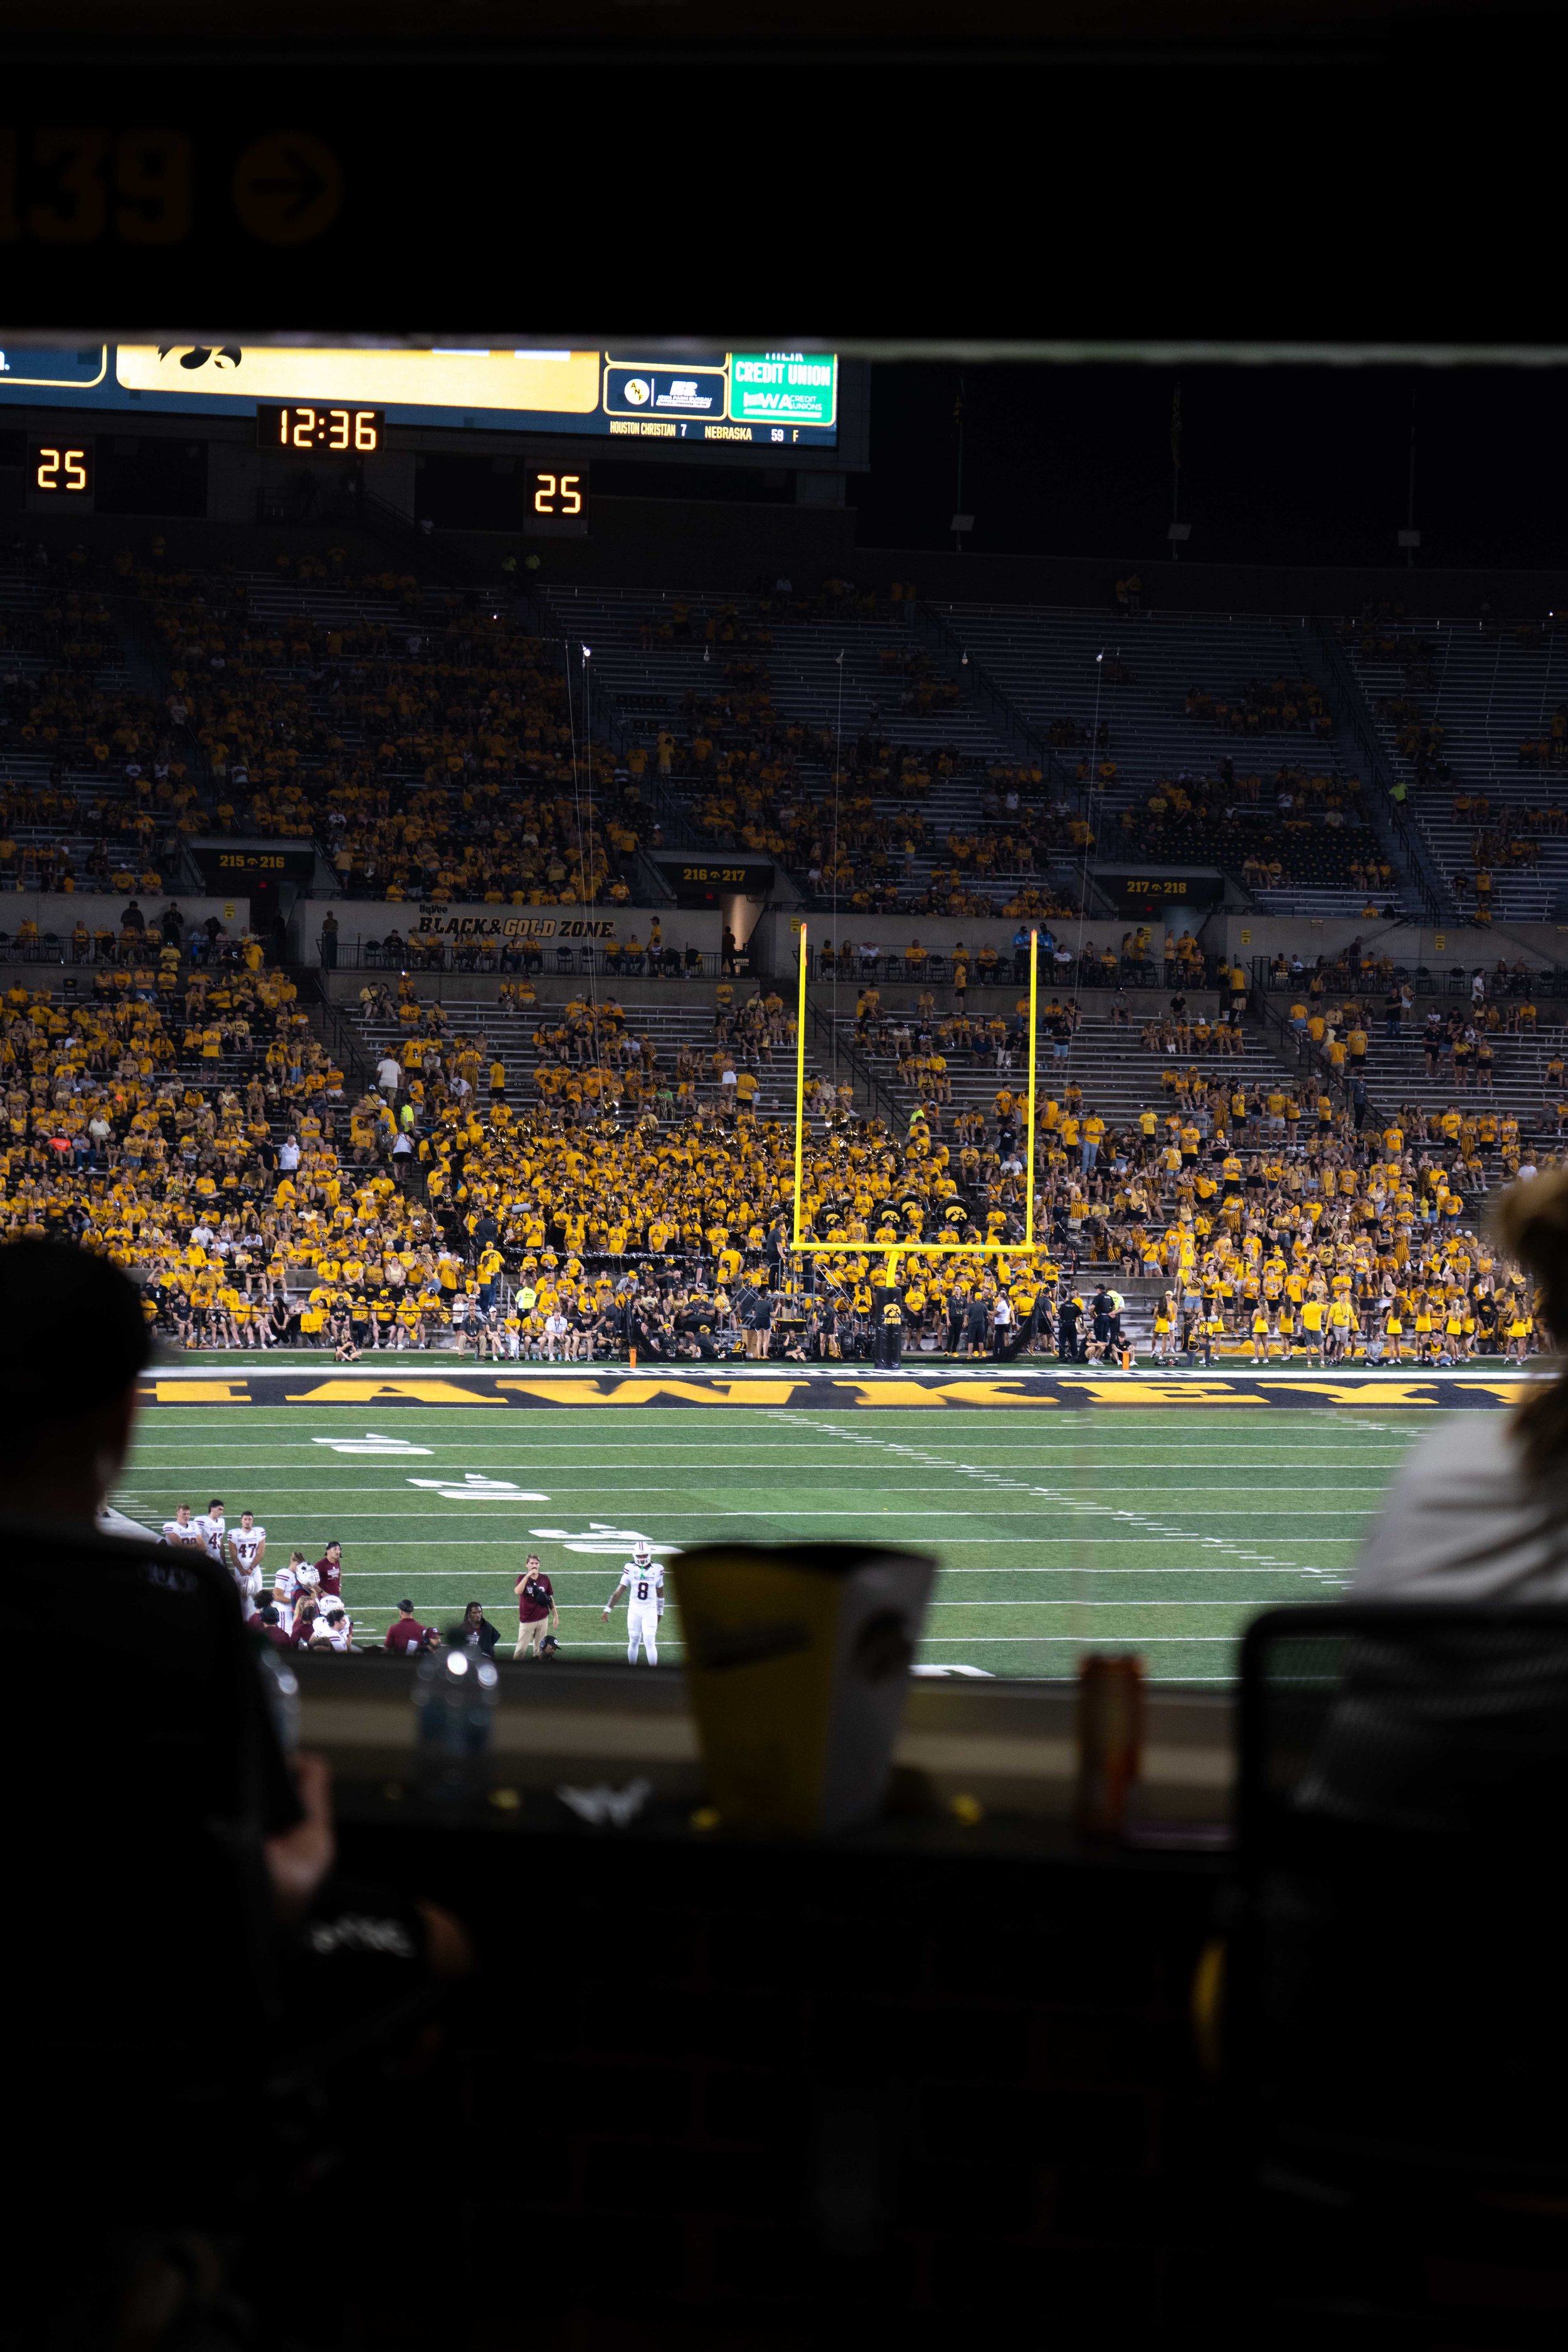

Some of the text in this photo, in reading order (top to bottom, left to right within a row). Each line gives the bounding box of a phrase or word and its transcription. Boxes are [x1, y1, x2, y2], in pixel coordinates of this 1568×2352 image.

[735, 361, 831, 386] CREDIT UNION
[791, 395, 817, 403] CREDIT
[792, 403, 822, 411] UNIONS
[280, 408, 376, 450] 12:36
[610, 421, 799, 442] HOUSTON CHRISTIAN 7 NEBRASKA 59 F
[37, 449, 85, 489] 25
[534, 474, 581, 514] 25
[219, 854, 285, 869] 215 216
[682, 868, 746, 882] 216 217
[1126, 881, 1187, 894] 217 218
[418, 916, 487, 935] BLACK
[502, 918, 557, 938] GOLD
[558, 919, 614, 938] ZONE
[238, 1544, 257, 1559] 47
[637, 1582, 649, 1601] 8
